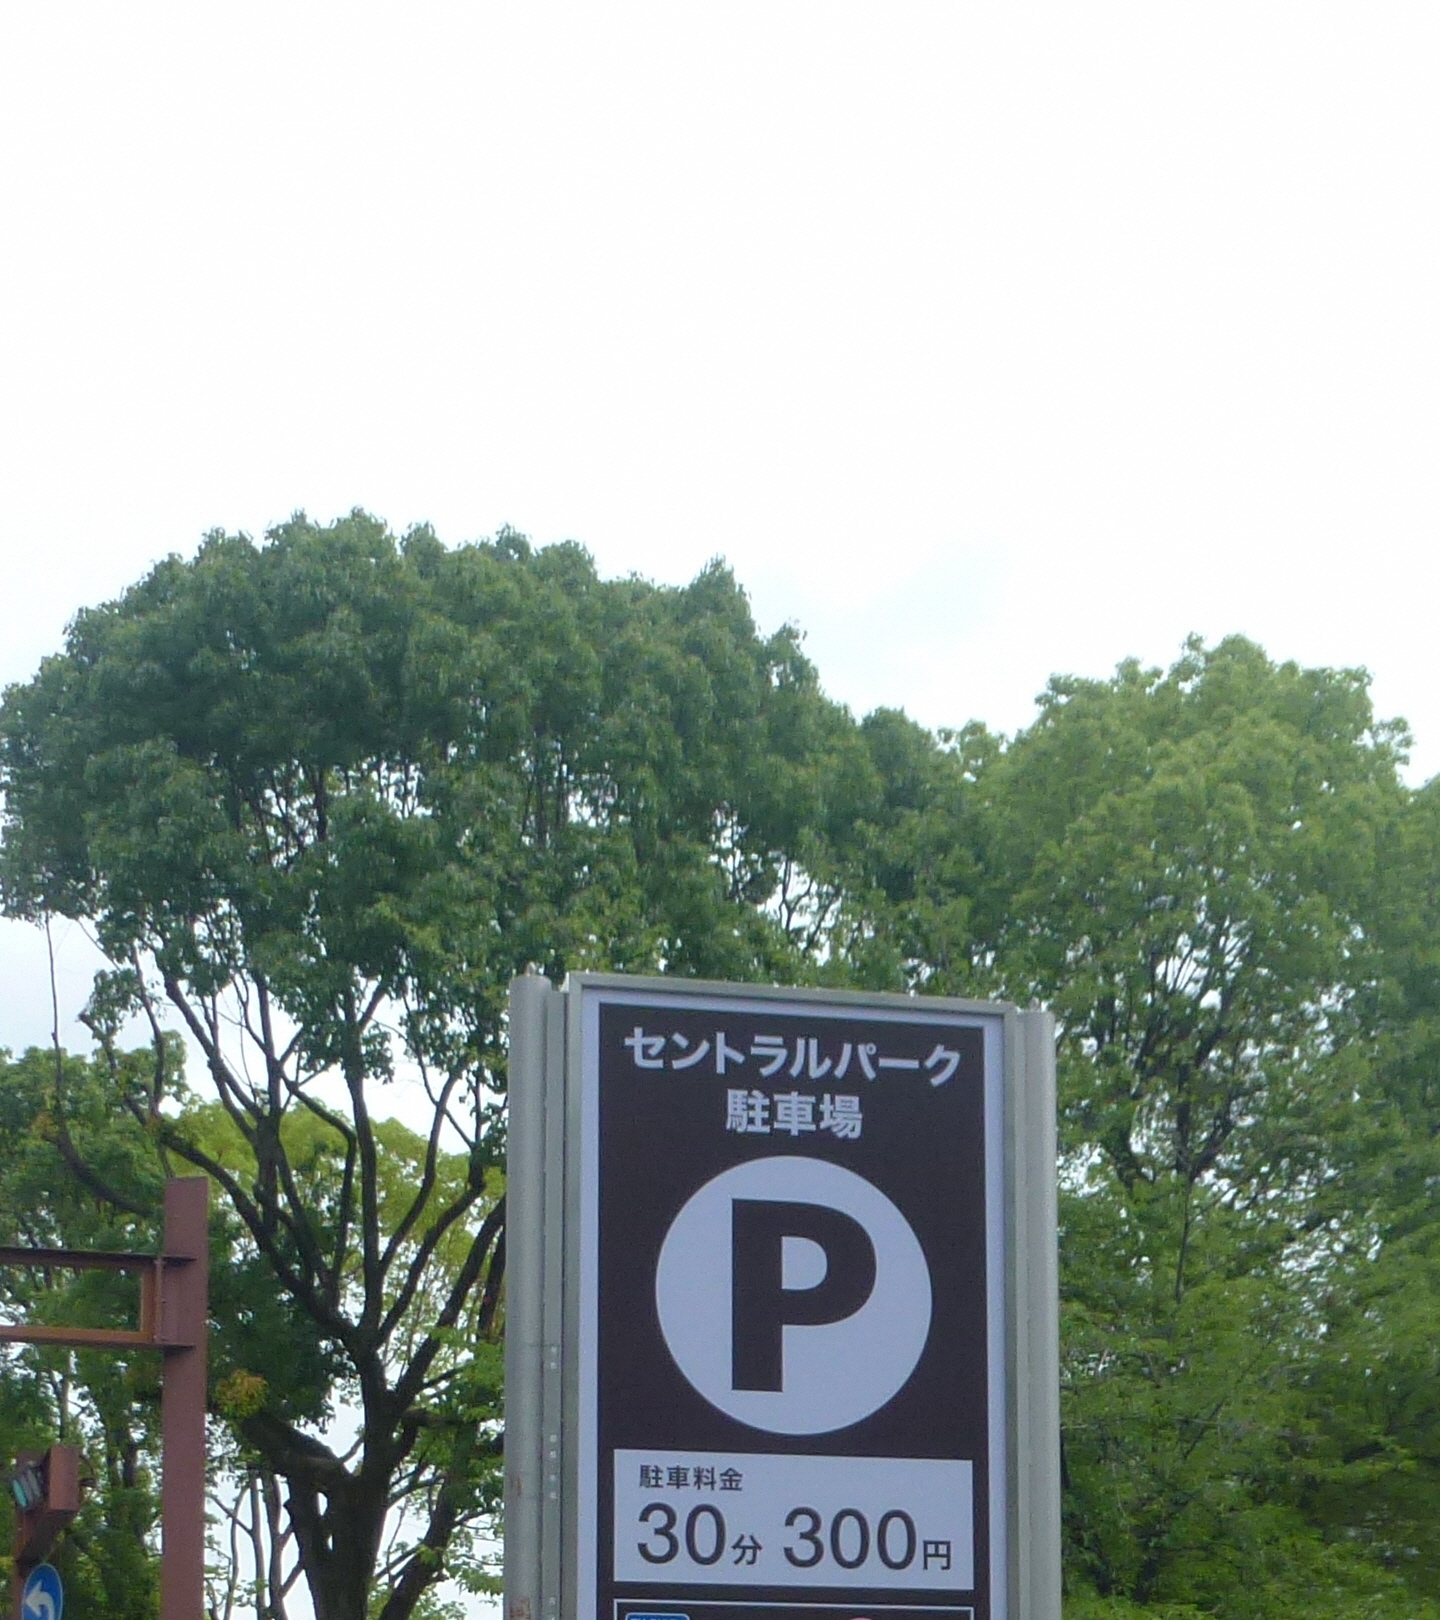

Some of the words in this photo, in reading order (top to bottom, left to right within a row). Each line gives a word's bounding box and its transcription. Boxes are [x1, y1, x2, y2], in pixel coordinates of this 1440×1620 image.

[624, 1026, 962, 1088] セントラルパーク
[725, 1088, 864, 1139] 駐車場
[731, 1197, 878, 1394] P
[638, 1463, 744, 1492] 駐車料金
[636, 1501, 764, 1566] 30分
[782, 1506, 953, 1572] 300円
